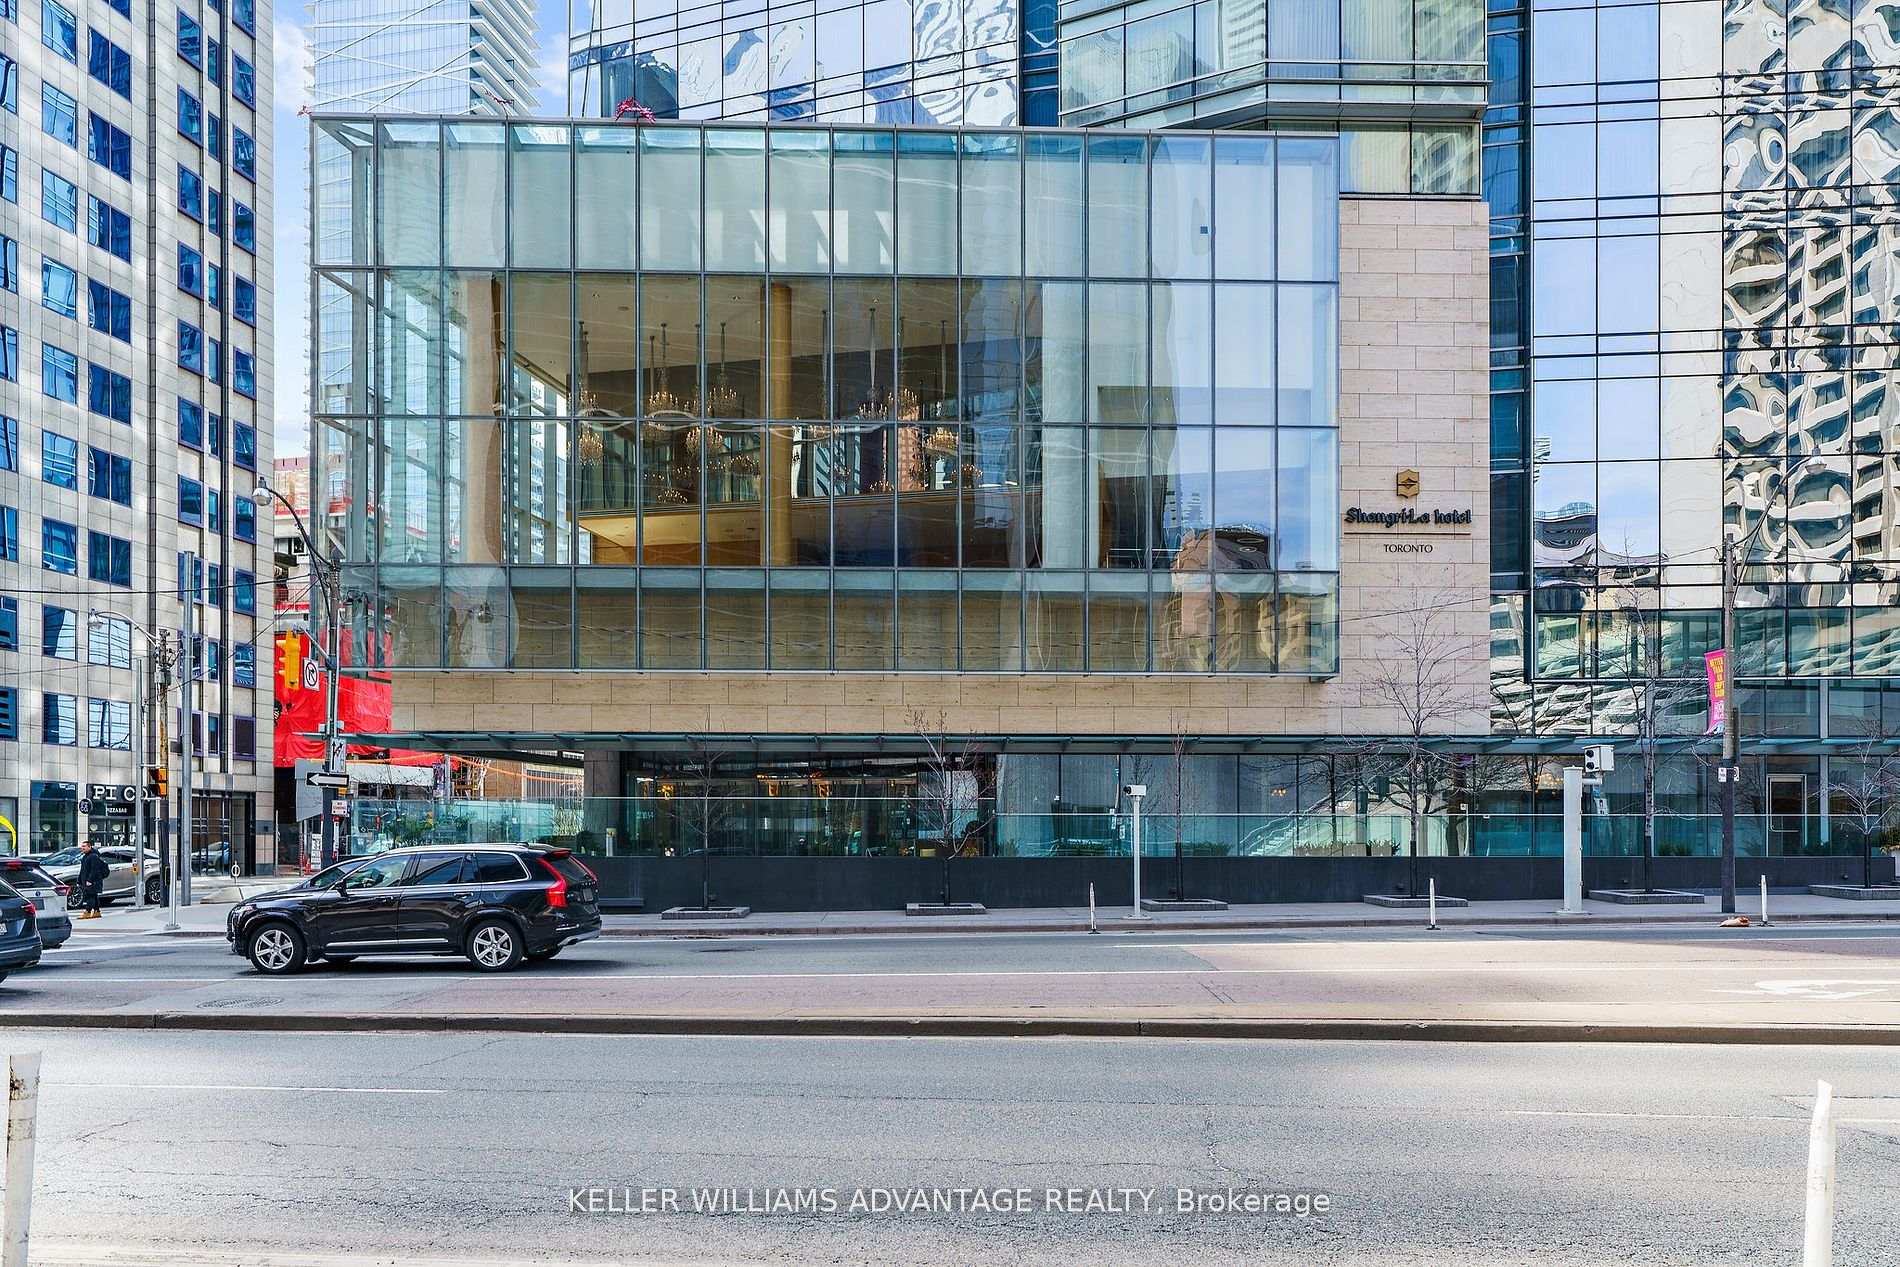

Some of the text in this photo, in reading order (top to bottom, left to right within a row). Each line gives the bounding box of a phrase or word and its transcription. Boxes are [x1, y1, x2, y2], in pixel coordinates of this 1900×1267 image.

[1434, 509, 1472, 524] hotel
[1383, 544, 1433, 553] TORONTO
[93, 785, 117, 800] PI
